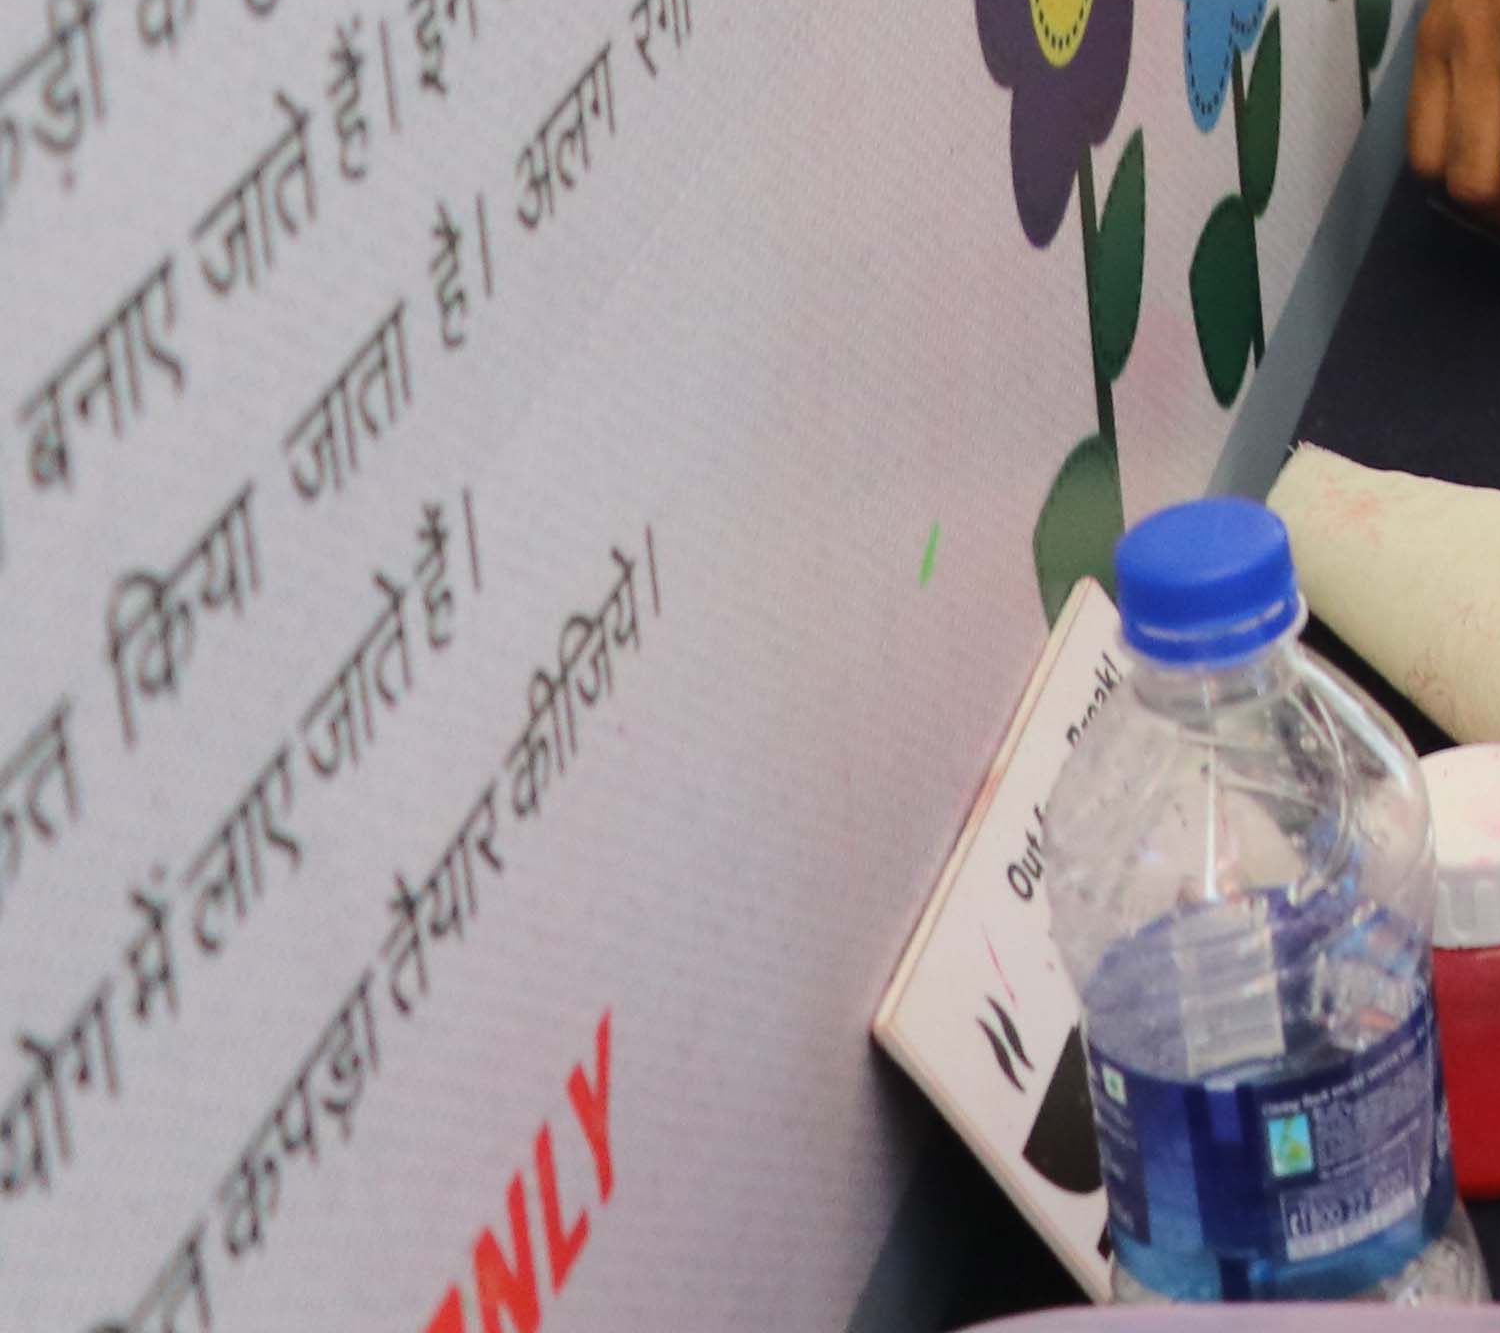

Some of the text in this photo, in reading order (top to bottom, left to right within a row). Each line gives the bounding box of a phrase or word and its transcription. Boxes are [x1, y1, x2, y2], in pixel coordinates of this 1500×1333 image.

[15, 248, 187, 494] बनाए
[189, 88, 318, 299] जाते
[105, 481, 264, 753] किया
[281, 296, 414, 505] जाता
[514, 39, 618, 232] अलग
[125, 862, 182, 1023] में
[182, 739, 304, 955] लाए
[297, 567, 416, 779] जाते
[380, 779, 507, 1021] तैयार
